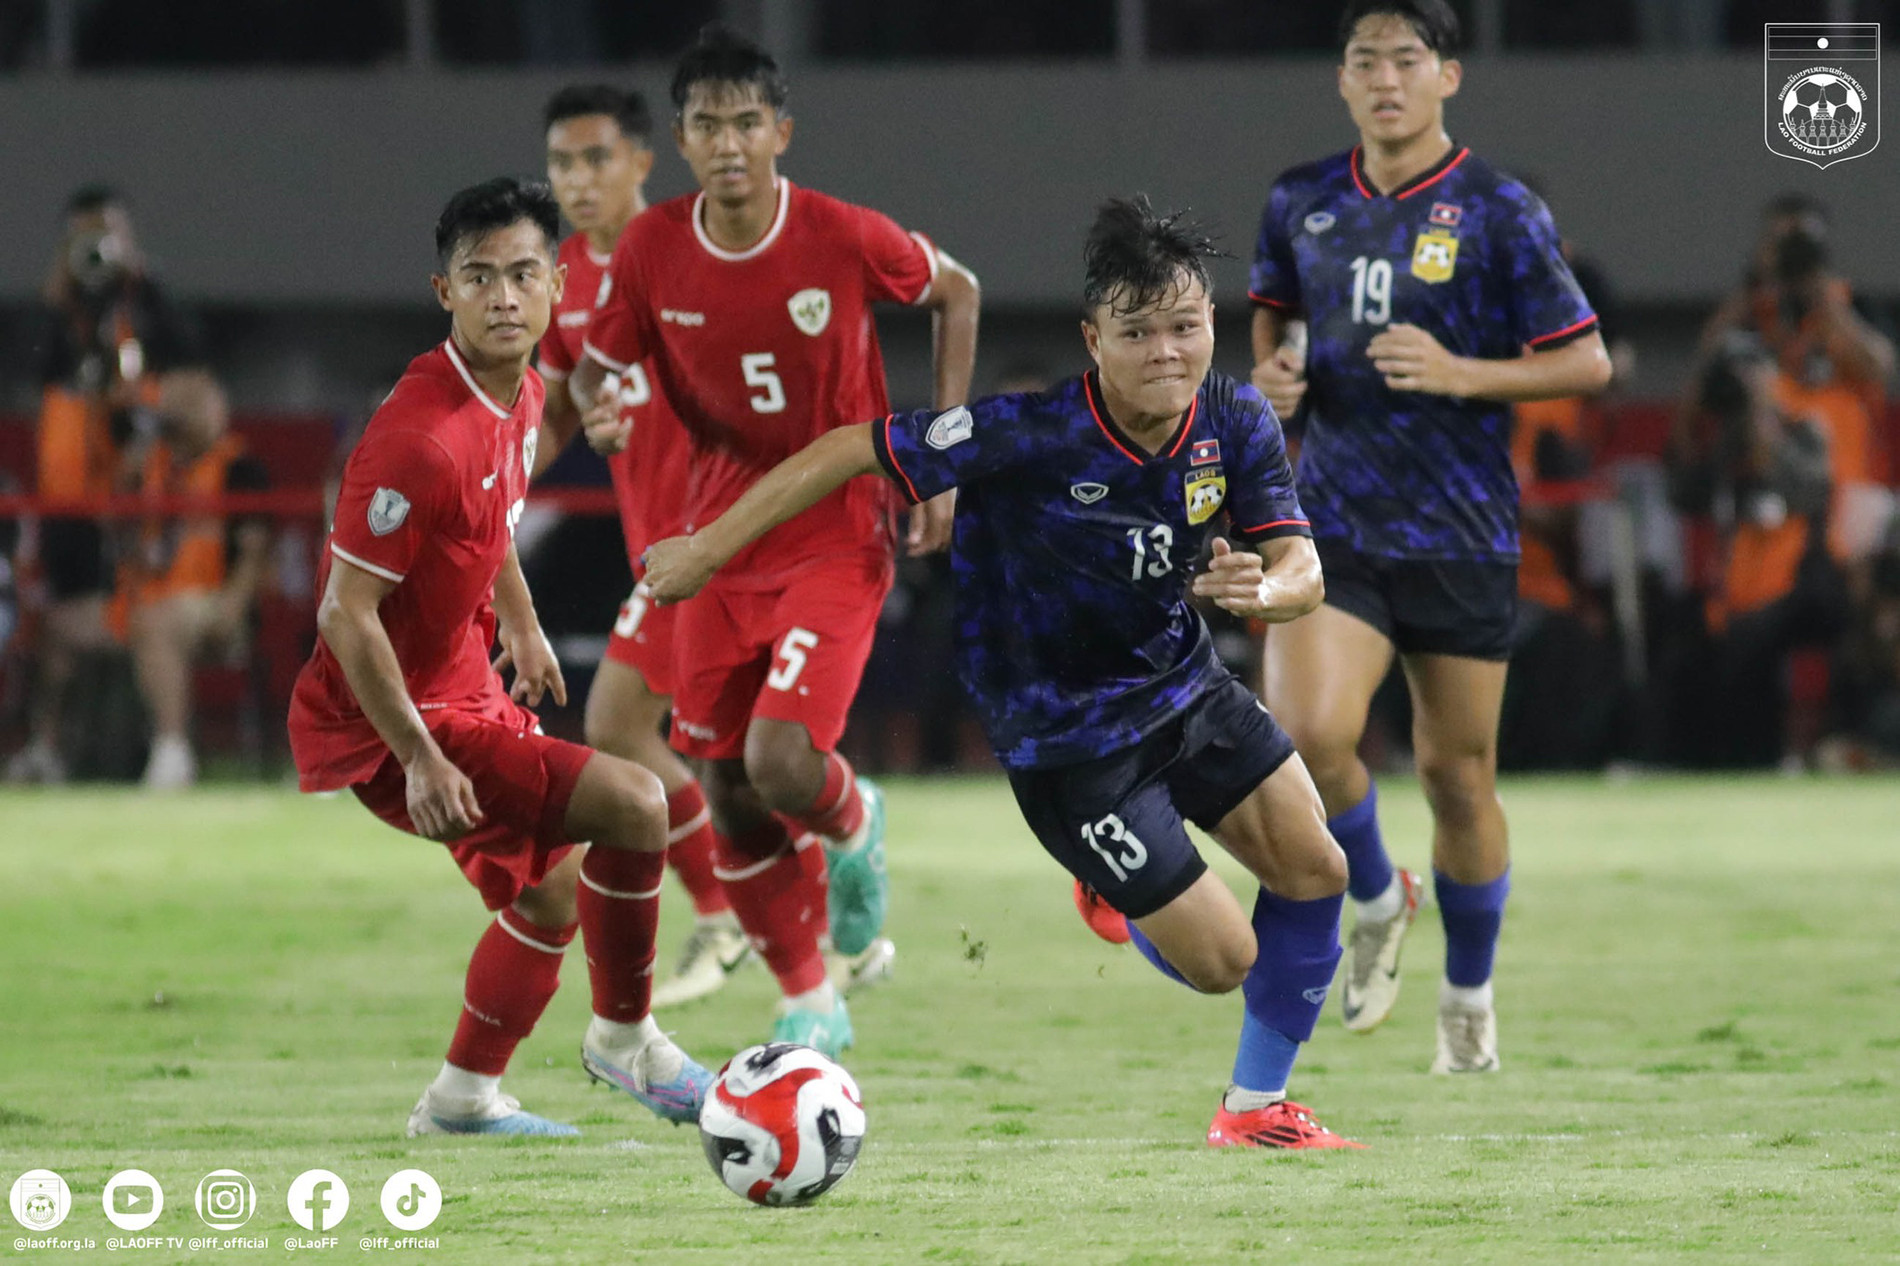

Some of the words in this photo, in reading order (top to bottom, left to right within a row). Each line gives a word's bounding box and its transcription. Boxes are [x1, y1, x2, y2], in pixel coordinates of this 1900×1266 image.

[1350, 256, 1393, 325] 19
[741, 352, 787, 414] 5
[1126, 523, 1174, 581] 13
[767, 626, 819, 692] 5
[1081, 812, 1148, 883] 13
